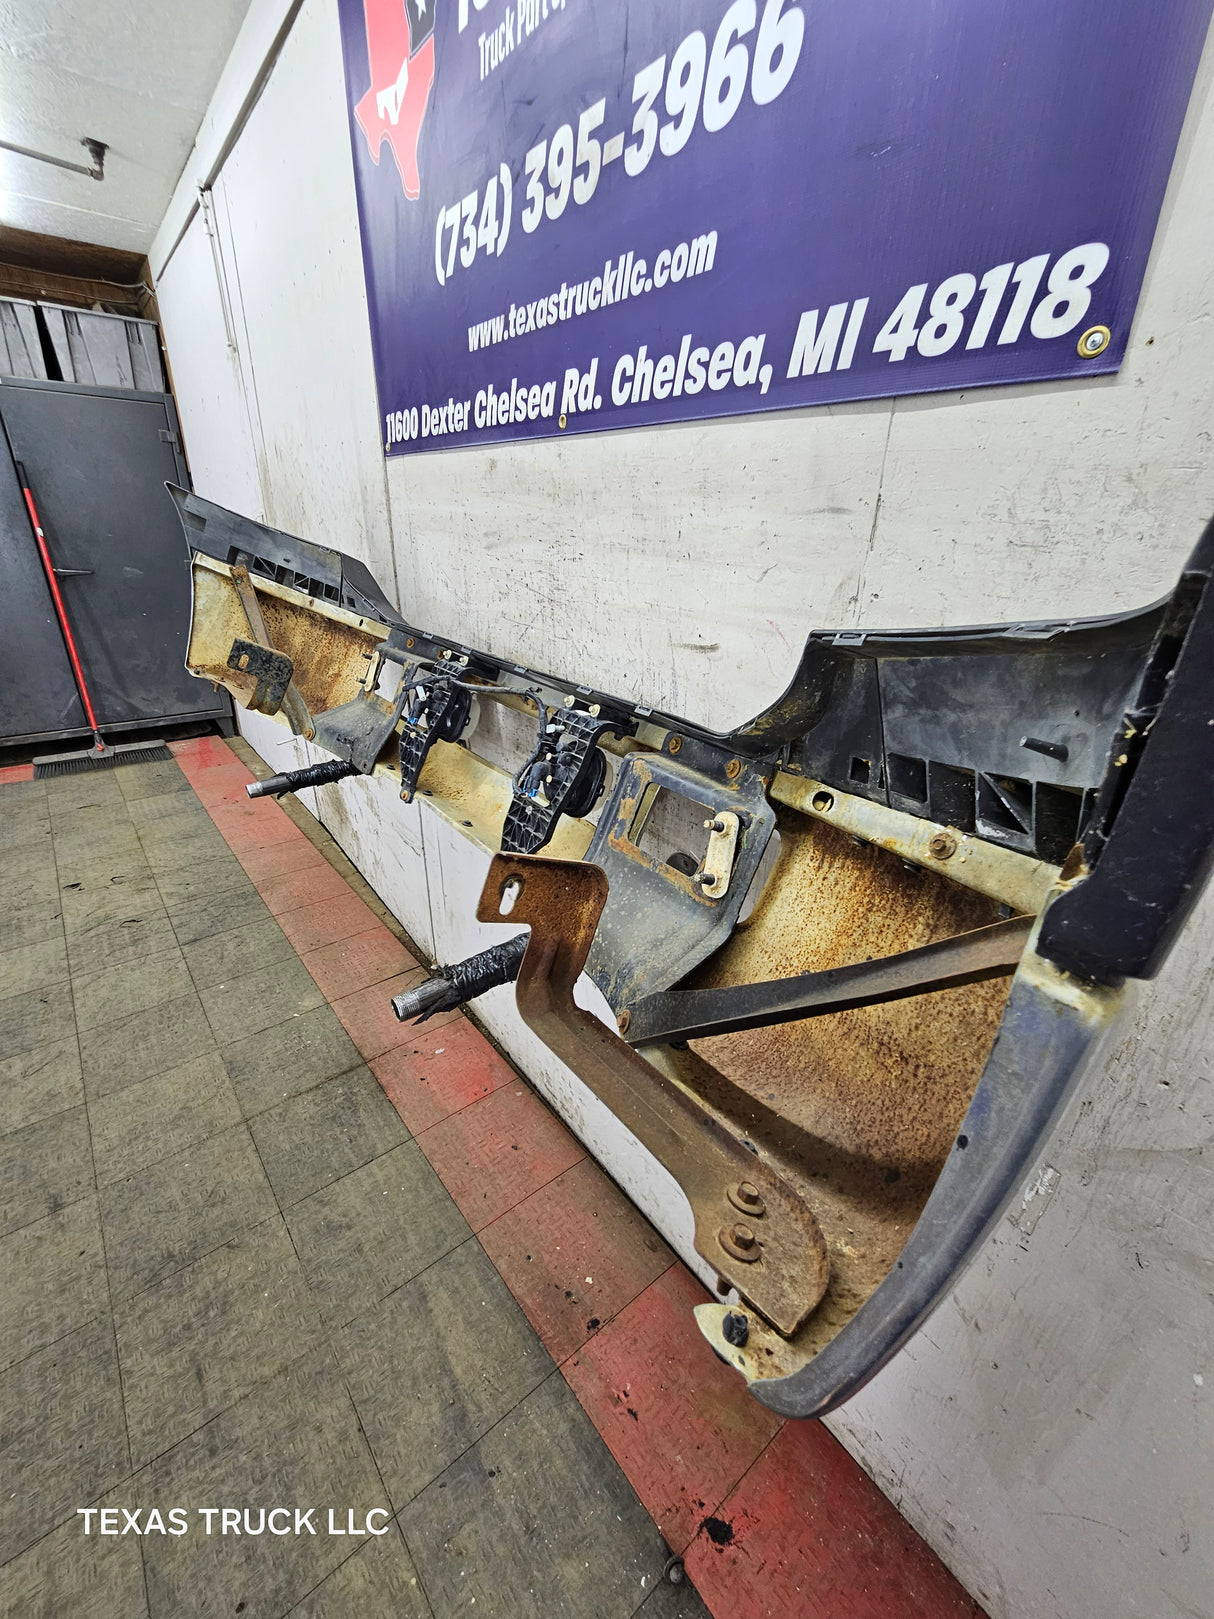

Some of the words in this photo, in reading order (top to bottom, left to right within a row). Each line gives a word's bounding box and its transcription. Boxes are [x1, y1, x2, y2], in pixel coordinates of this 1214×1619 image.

[478, 5, 514, 81] Truck
[435, 163, 512, 286] (734)
[521, 0, 805, 233] 395-3966
[386, 406, 418, 443] 11600
[421, 397, 470, 438] Dexter
[474, 378, 556, 429] Chelsea
[560, 357, 602, 414] Rd.
[611, 333, 773, 406] Chelsea,
[786, 297, 869, 379] MI
[872, 242, 1110, 362] 48118
[468, 230, 718, 352] www.texastruckllc.com
